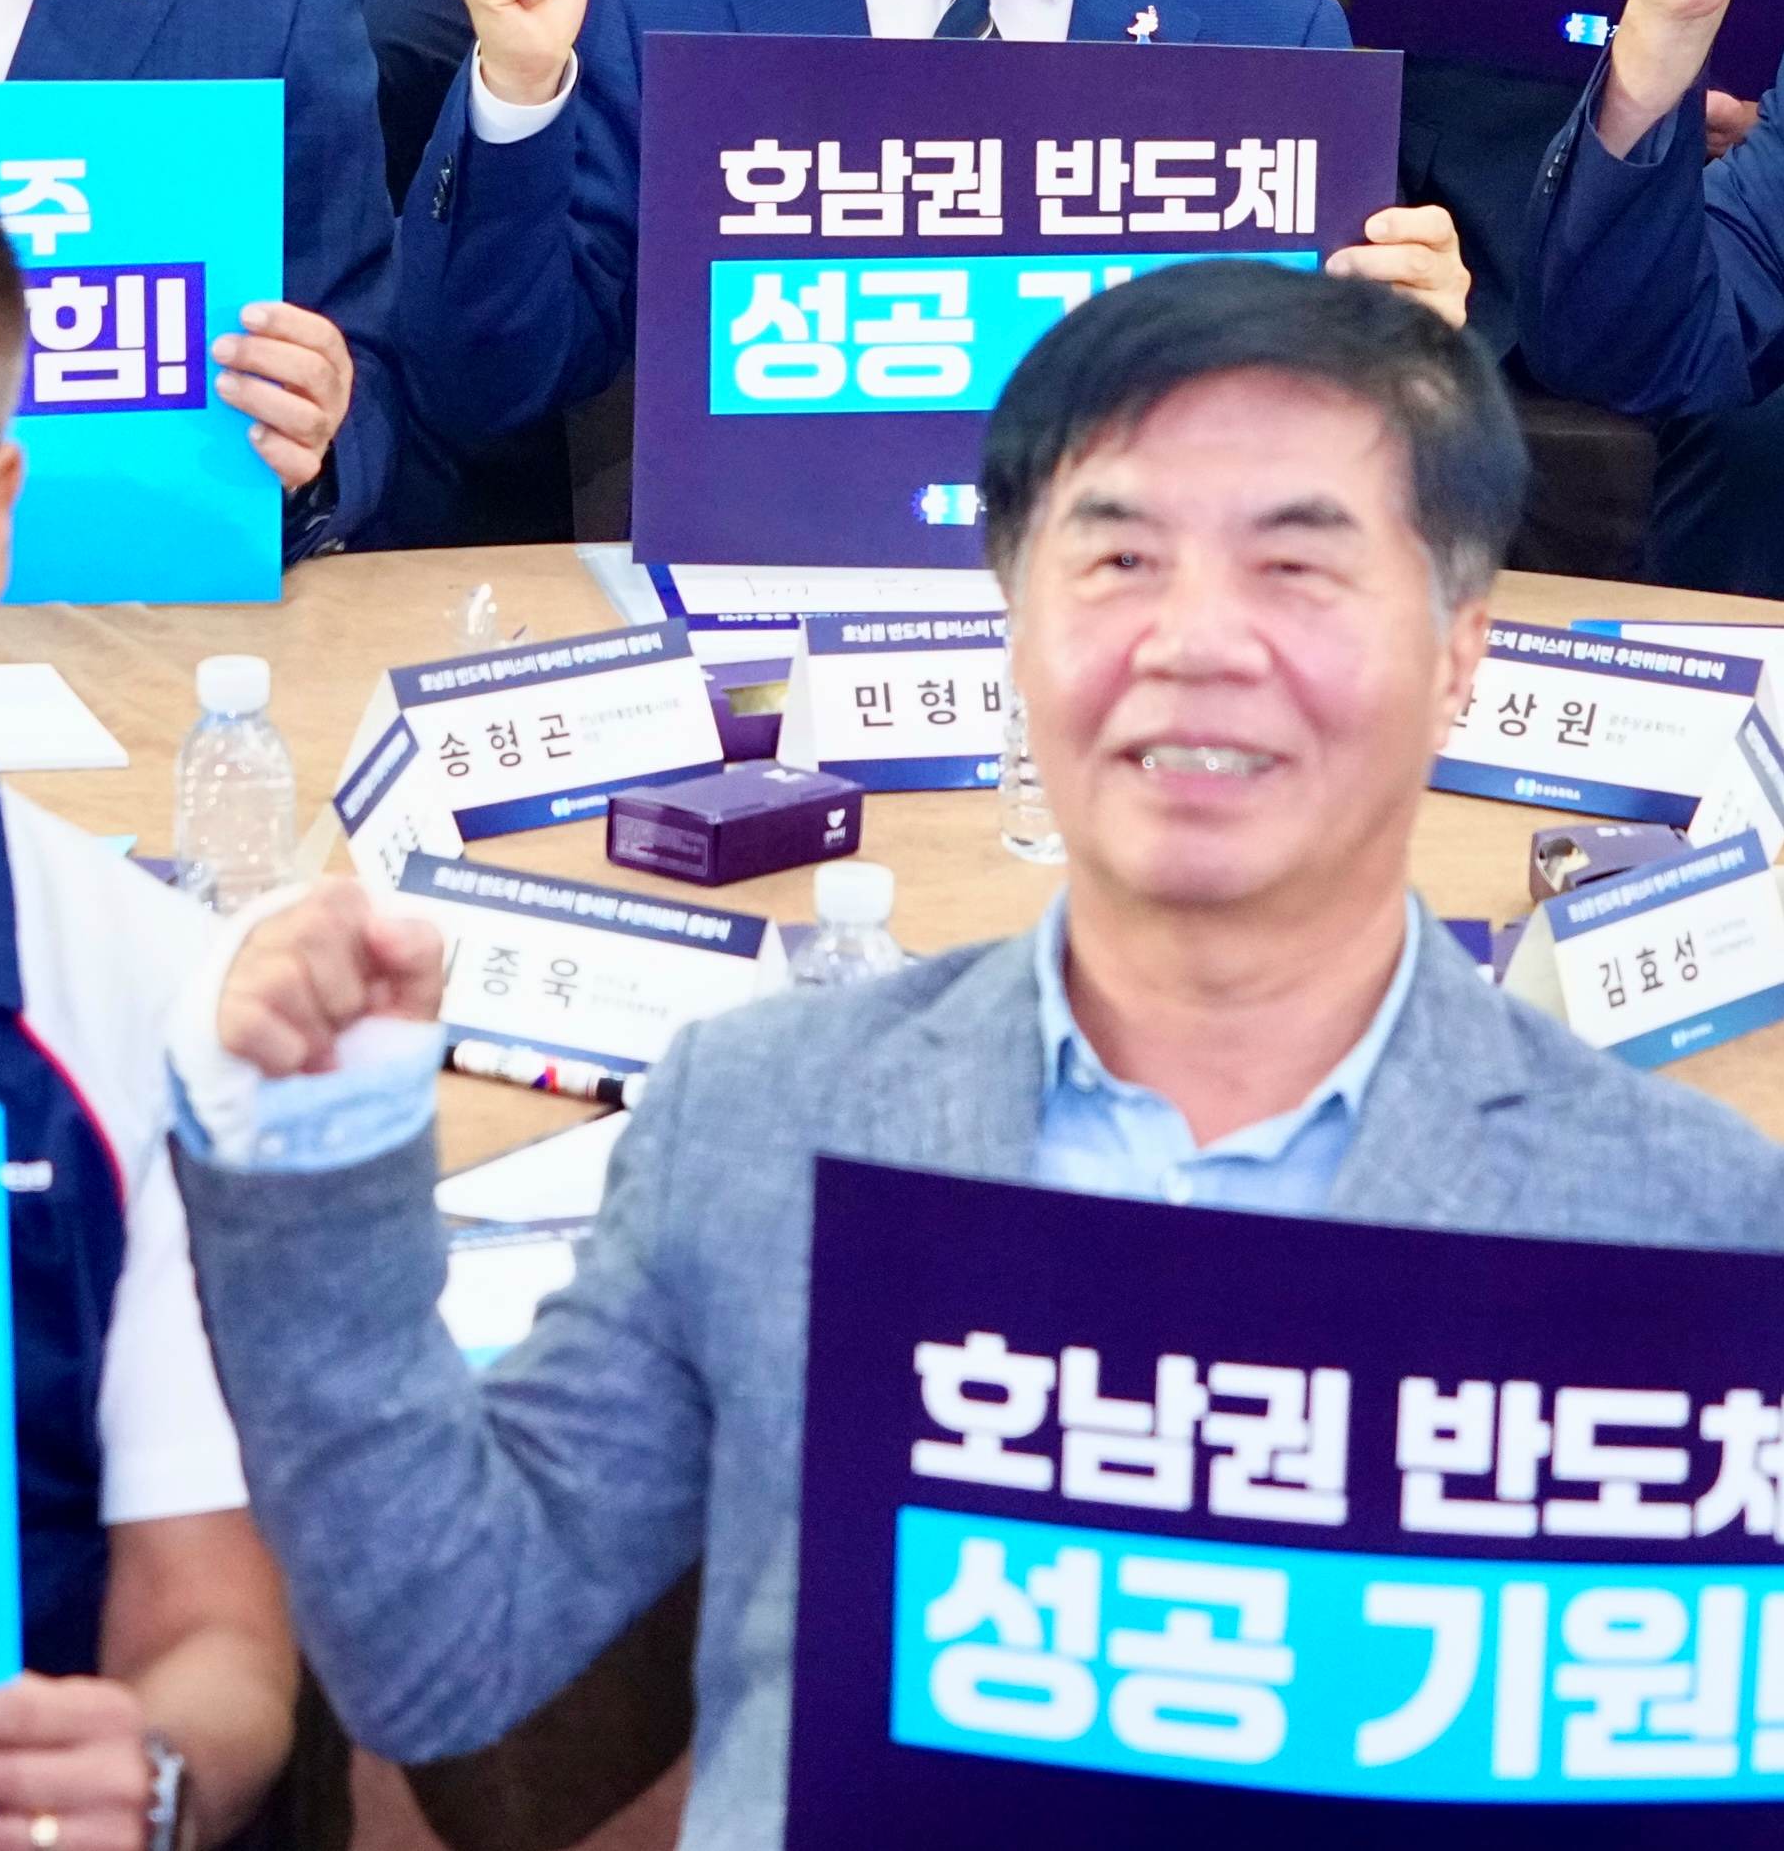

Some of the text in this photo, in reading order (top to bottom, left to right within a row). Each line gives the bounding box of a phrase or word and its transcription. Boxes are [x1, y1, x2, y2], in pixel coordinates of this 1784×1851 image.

[719, 138, 1318, 237] 호남권 반도체
[29, 272, 189, 403] 힘!
[730, 269, 975, 402] 성공
[1484, 629, 1518, 650] 도체
[910, 1330, 1351, 1527] 호남권
[925, 1536, 1295, 1768] 성공
